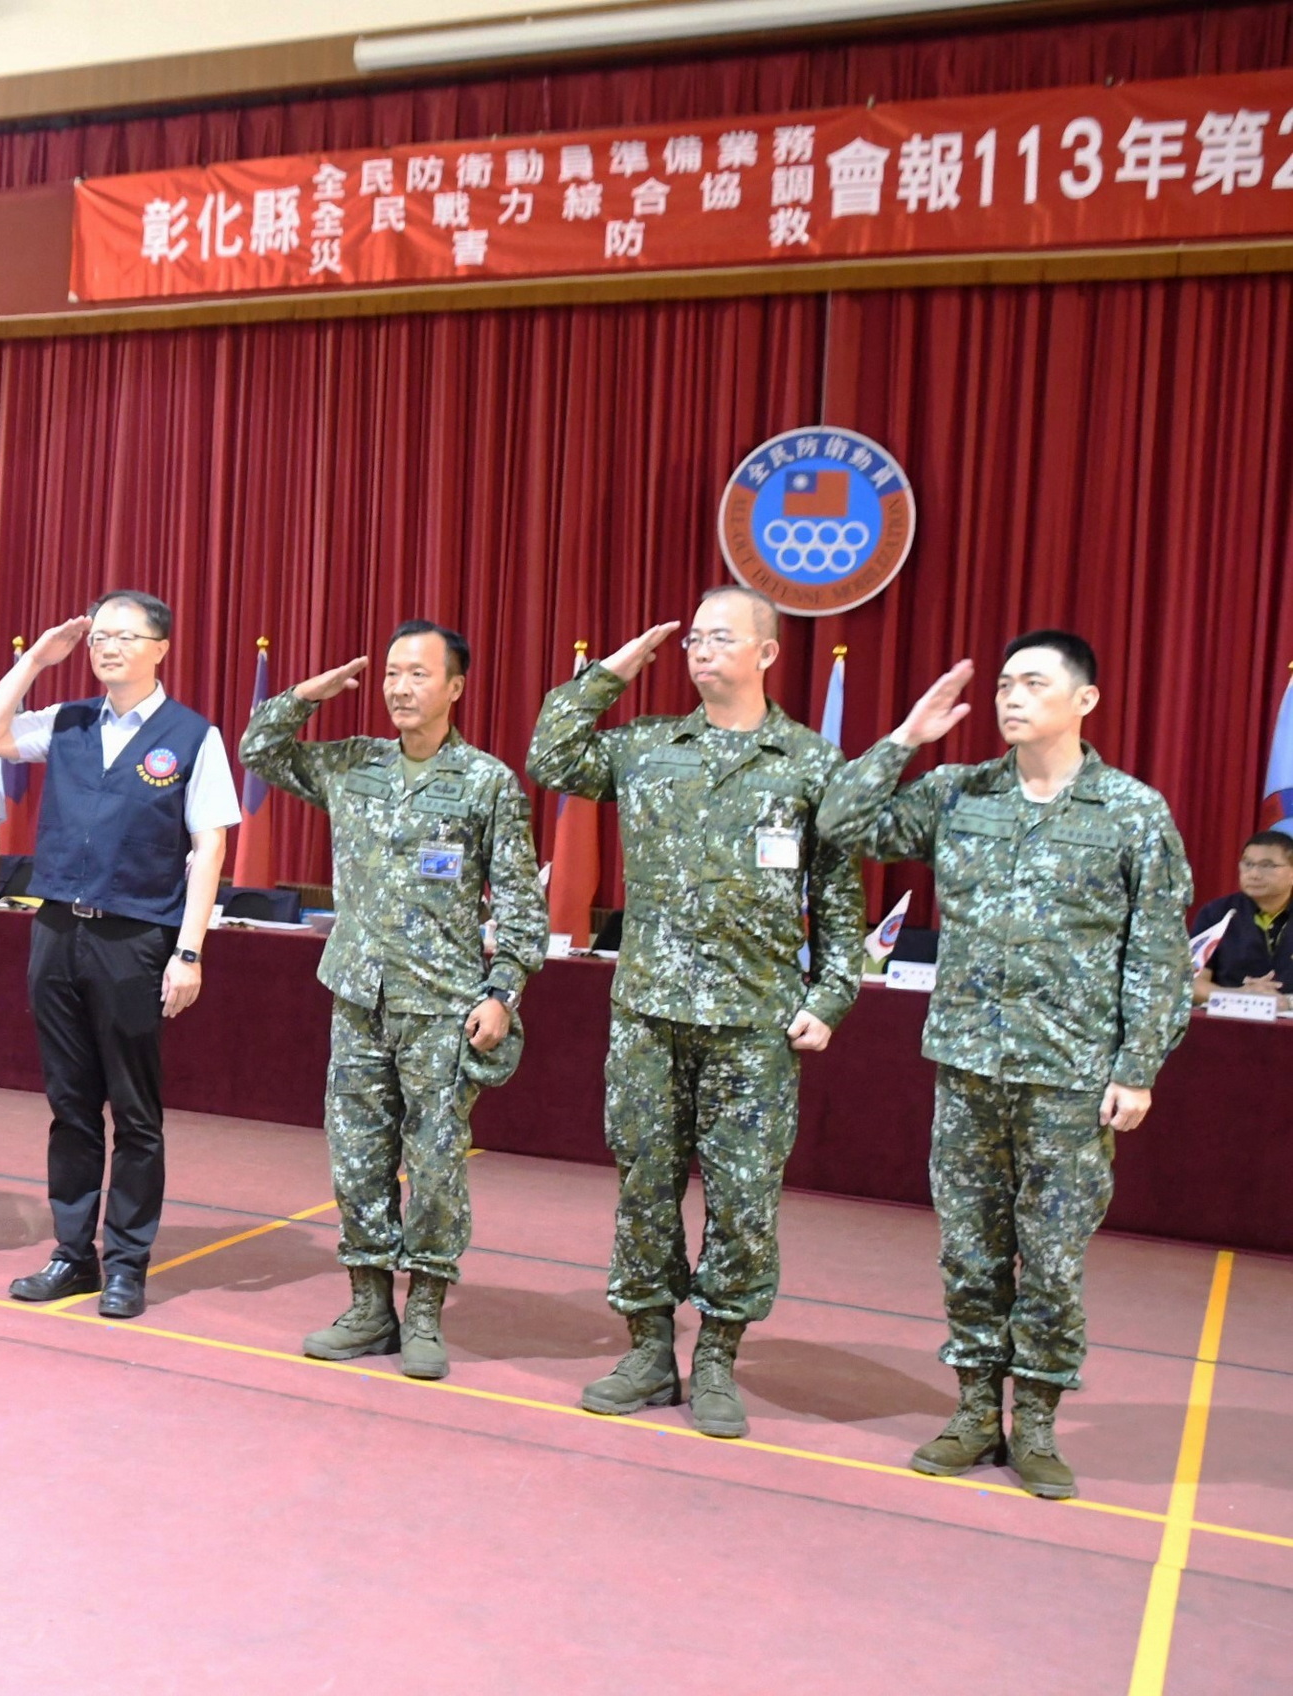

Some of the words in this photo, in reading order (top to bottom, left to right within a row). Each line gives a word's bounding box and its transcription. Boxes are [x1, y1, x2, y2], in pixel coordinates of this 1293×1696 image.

[312, 124, 816, 201] 全民防衛動員準備業務
[140, 185, 302, 264] 彰化縣
[311, 166, 814, 239] 全民戰力綜合協調
[309, 209, 810, 276] 災害防救
